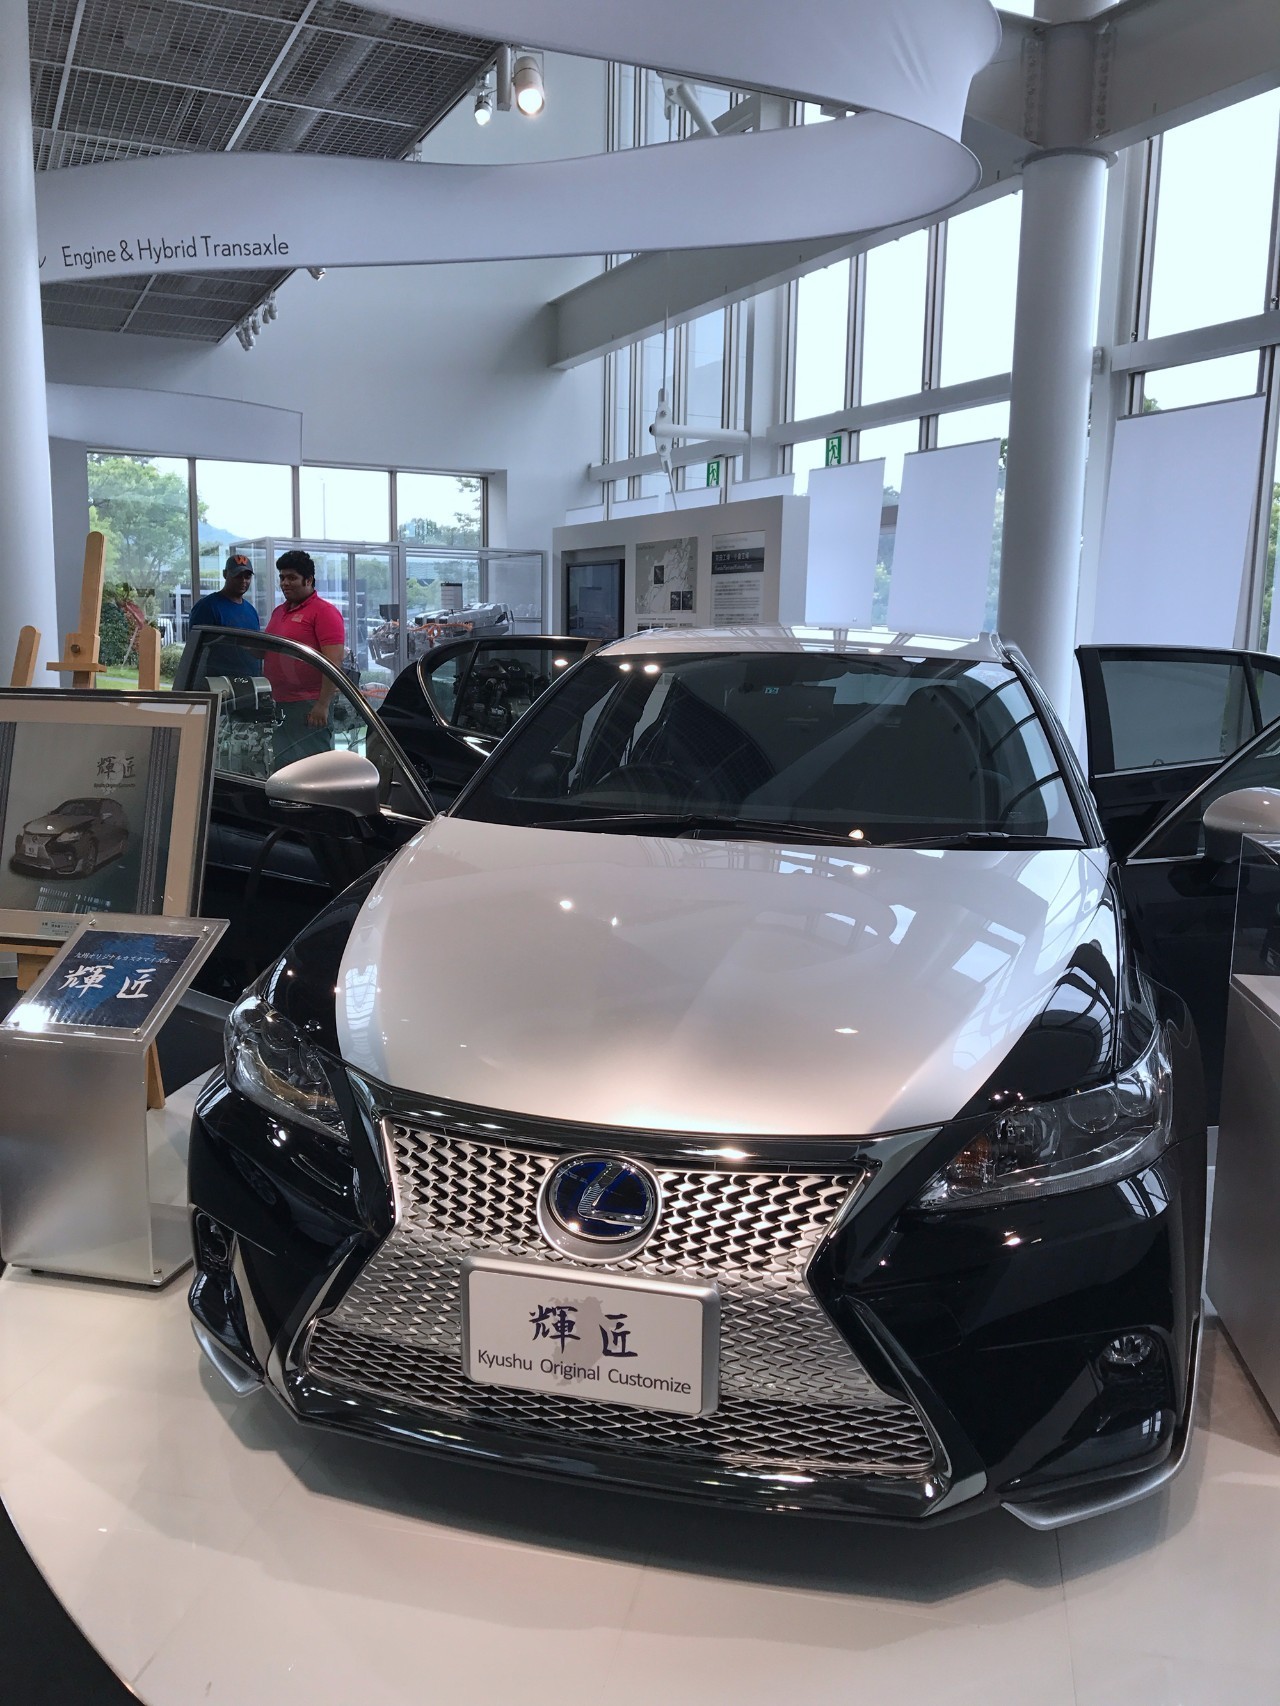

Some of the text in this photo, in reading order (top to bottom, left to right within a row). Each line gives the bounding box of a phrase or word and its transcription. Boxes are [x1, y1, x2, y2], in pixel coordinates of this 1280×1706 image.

[61, 245, 117, 270] Engine
[119, 239, 135, 262] &
[137, 236, 198, 264] Hybrid
[200, 233, 289, 258] Transaxle
[477, 1349, 692, 1395] Kyushu Original Customize
